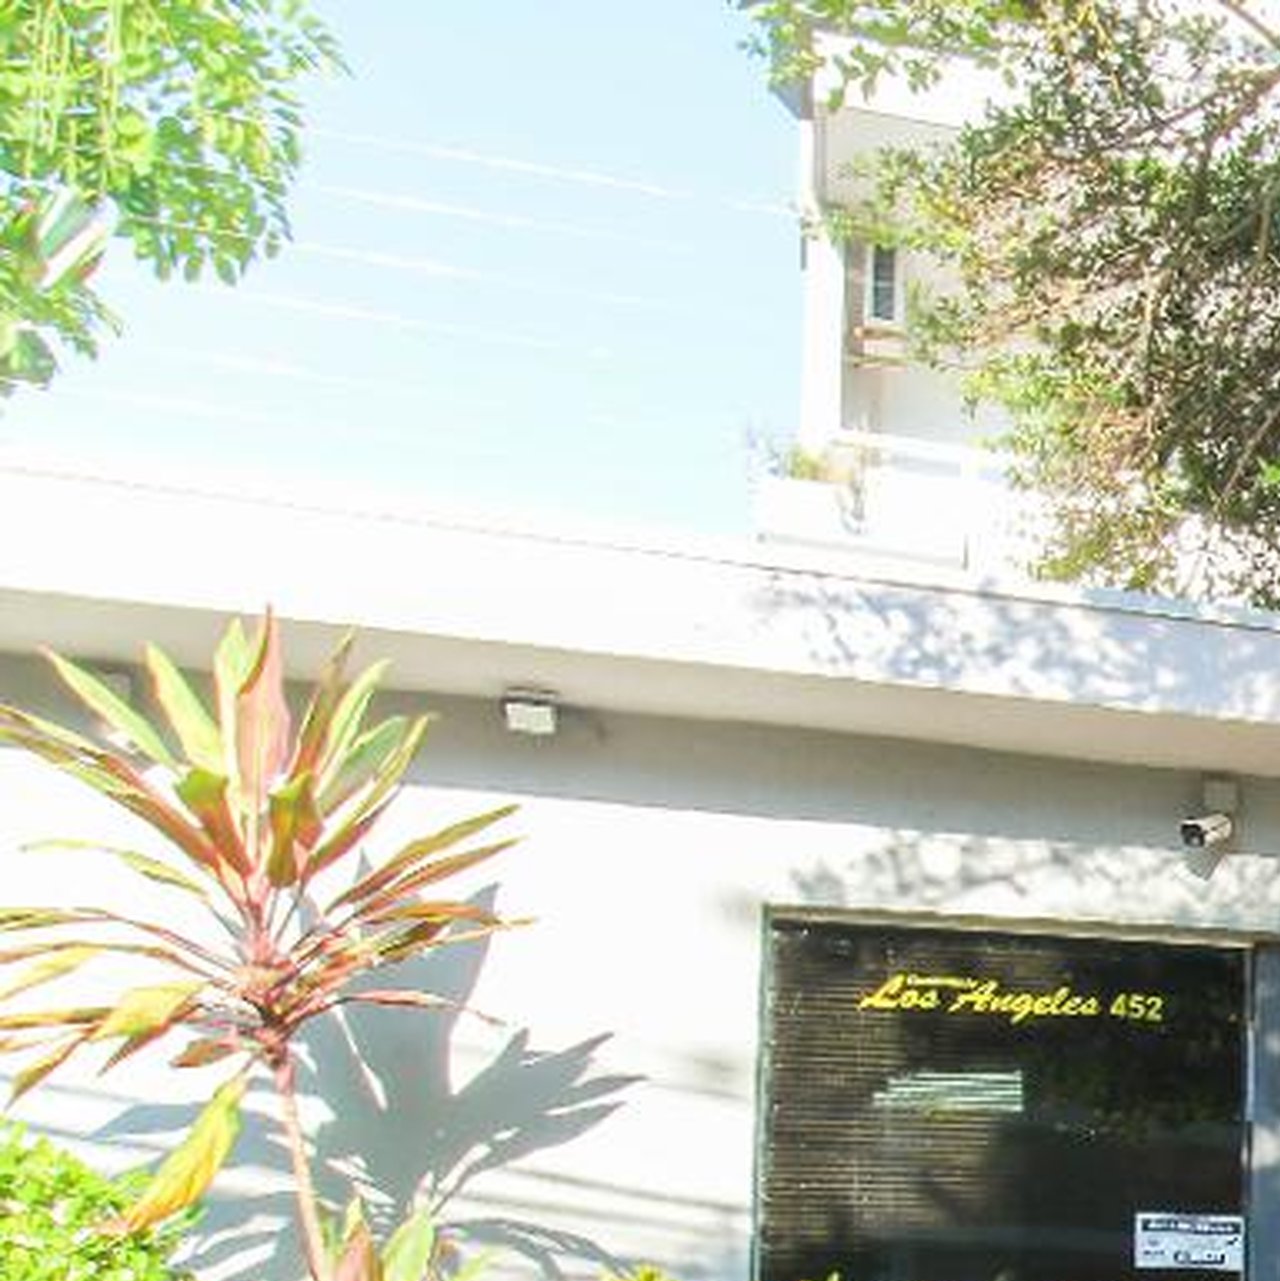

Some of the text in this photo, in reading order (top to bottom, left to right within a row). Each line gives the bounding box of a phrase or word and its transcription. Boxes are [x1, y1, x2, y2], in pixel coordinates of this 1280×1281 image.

[858, 972, 940, 1010] Los
[949, 979, 1101, 1025] Angeles
[1109, 994, 1164, 1021] 452
